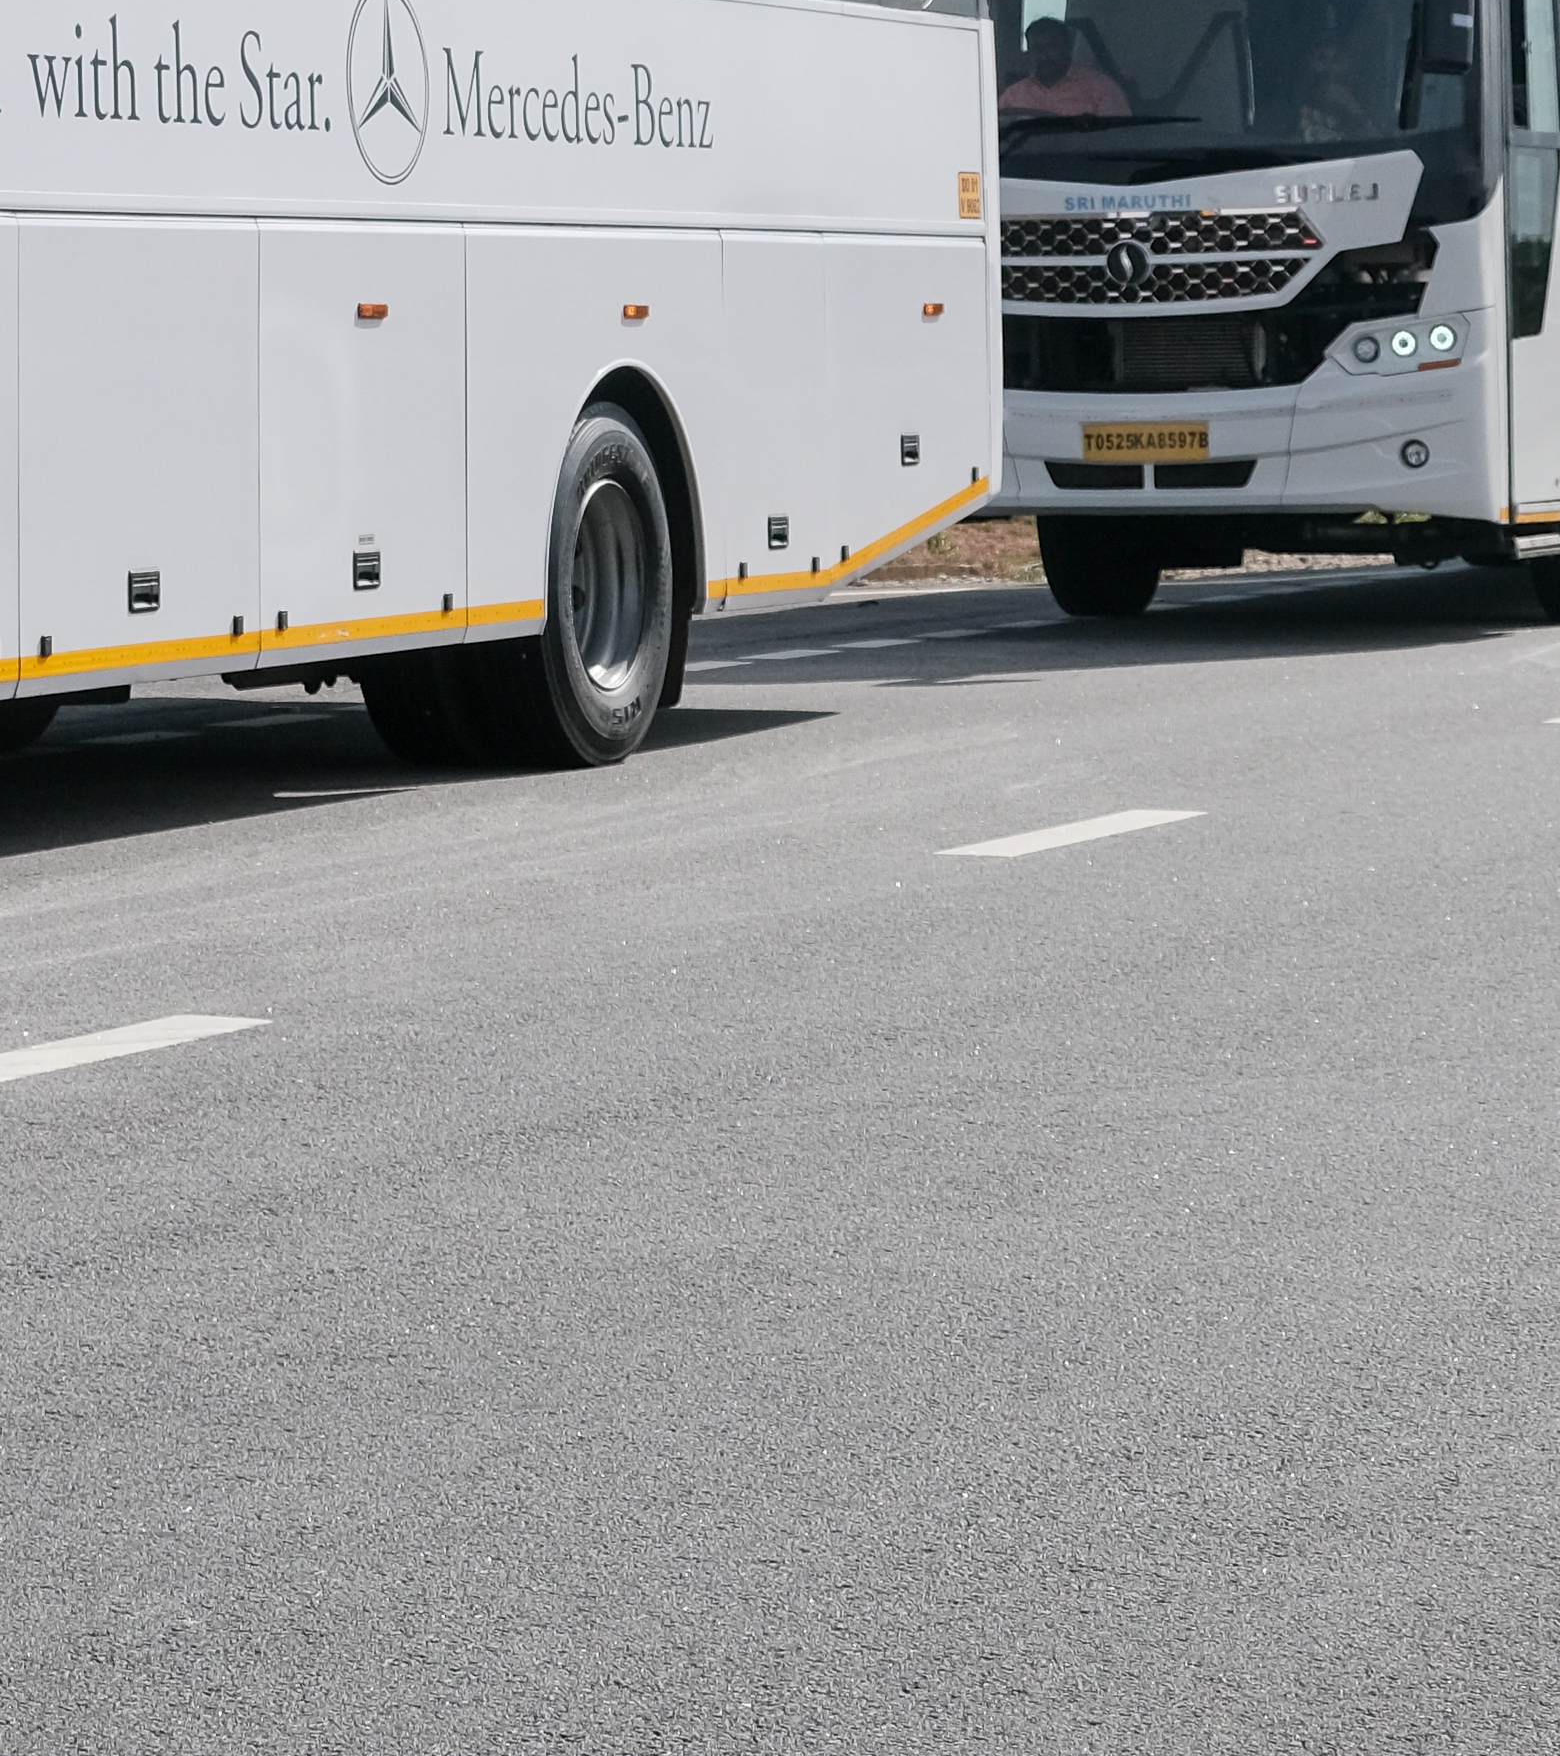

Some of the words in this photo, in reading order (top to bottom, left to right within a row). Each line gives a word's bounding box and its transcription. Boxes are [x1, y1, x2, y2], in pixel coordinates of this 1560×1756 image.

[27, 13, 141, 121] with
[153, 19, 226, 128] the
[240, 30, 332, 132] Star.
[442, 46, 714, 149] Mercedes-Benz
[1065, 195, 1095, 211] SRI
[1102, 193, 1192, 210] MARUTHI
[1273, 183, 1379, 204] SUTLEJ
